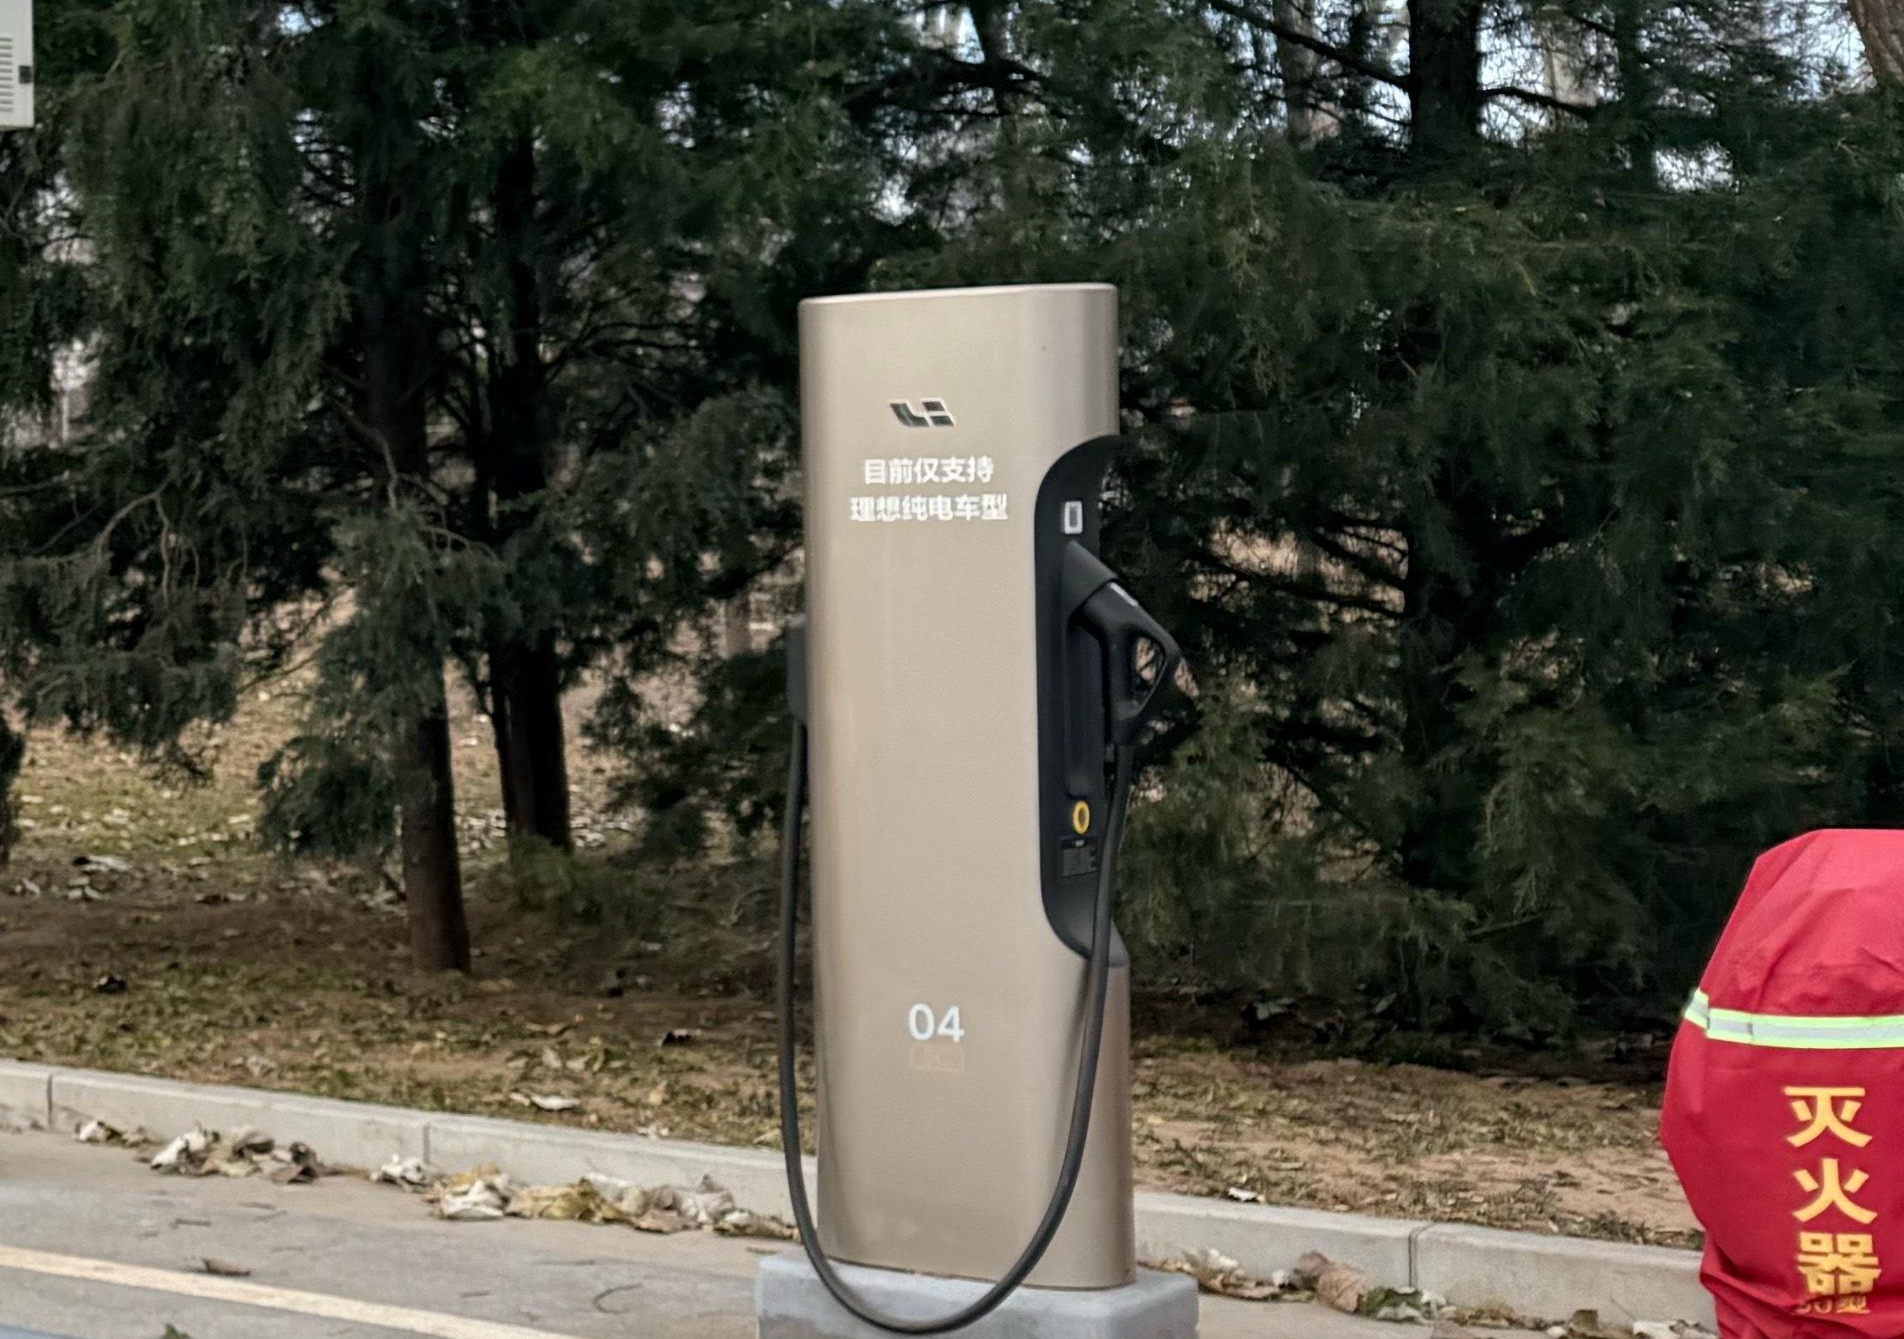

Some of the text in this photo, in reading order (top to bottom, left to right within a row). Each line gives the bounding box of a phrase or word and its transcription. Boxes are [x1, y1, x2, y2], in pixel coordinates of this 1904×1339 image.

[863, 456, 994, 485] 目前仅支持
[850, 494, 1009, 523] 理想纯电车型
[908, 1003, 965, 1043] 04
[1783, 1086, 1882, 1295] 灭火器
